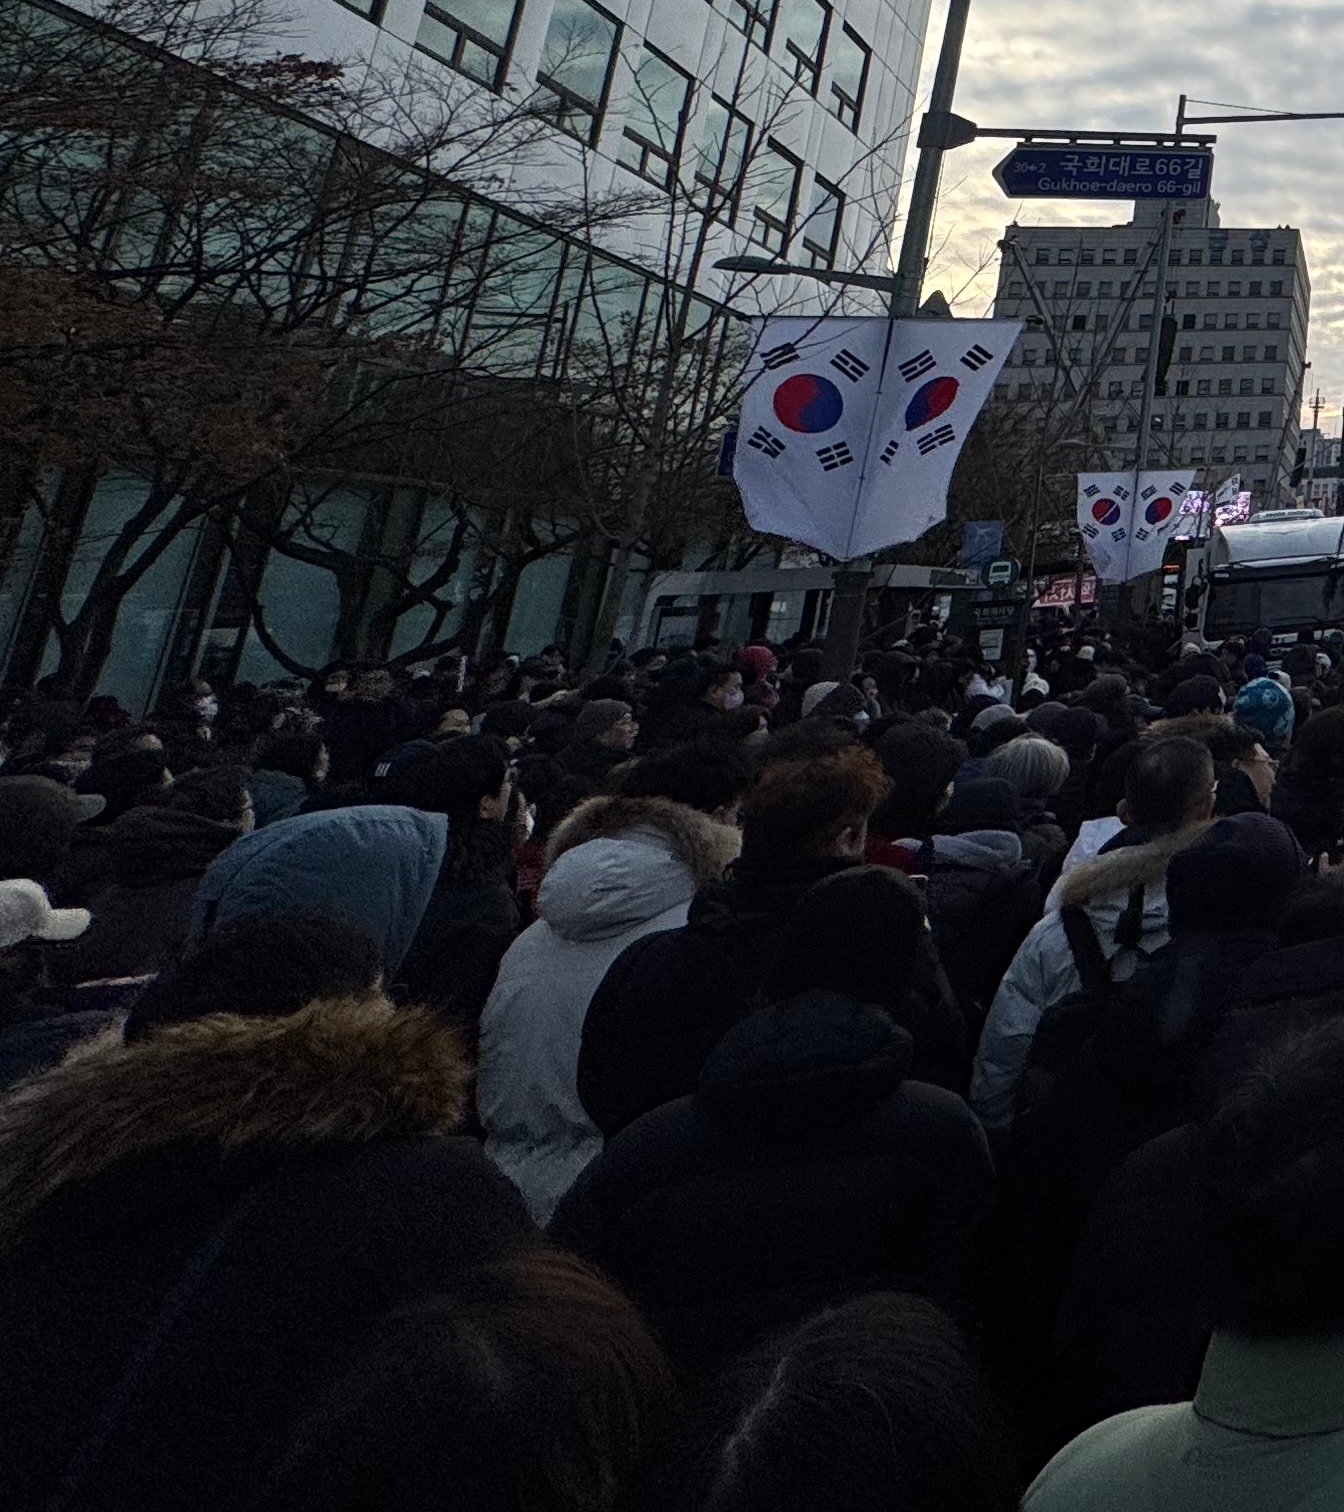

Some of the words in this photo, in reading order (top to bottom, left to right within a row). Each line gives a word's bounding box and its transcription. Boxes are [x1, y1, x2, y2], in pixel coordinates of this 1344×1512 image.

[1059, 155, 1204, 180] 국회대로66길
[1037, 176, 1153, 194] Gukhoe-daero
[1156, 179, 1201, 196] 66-gil
